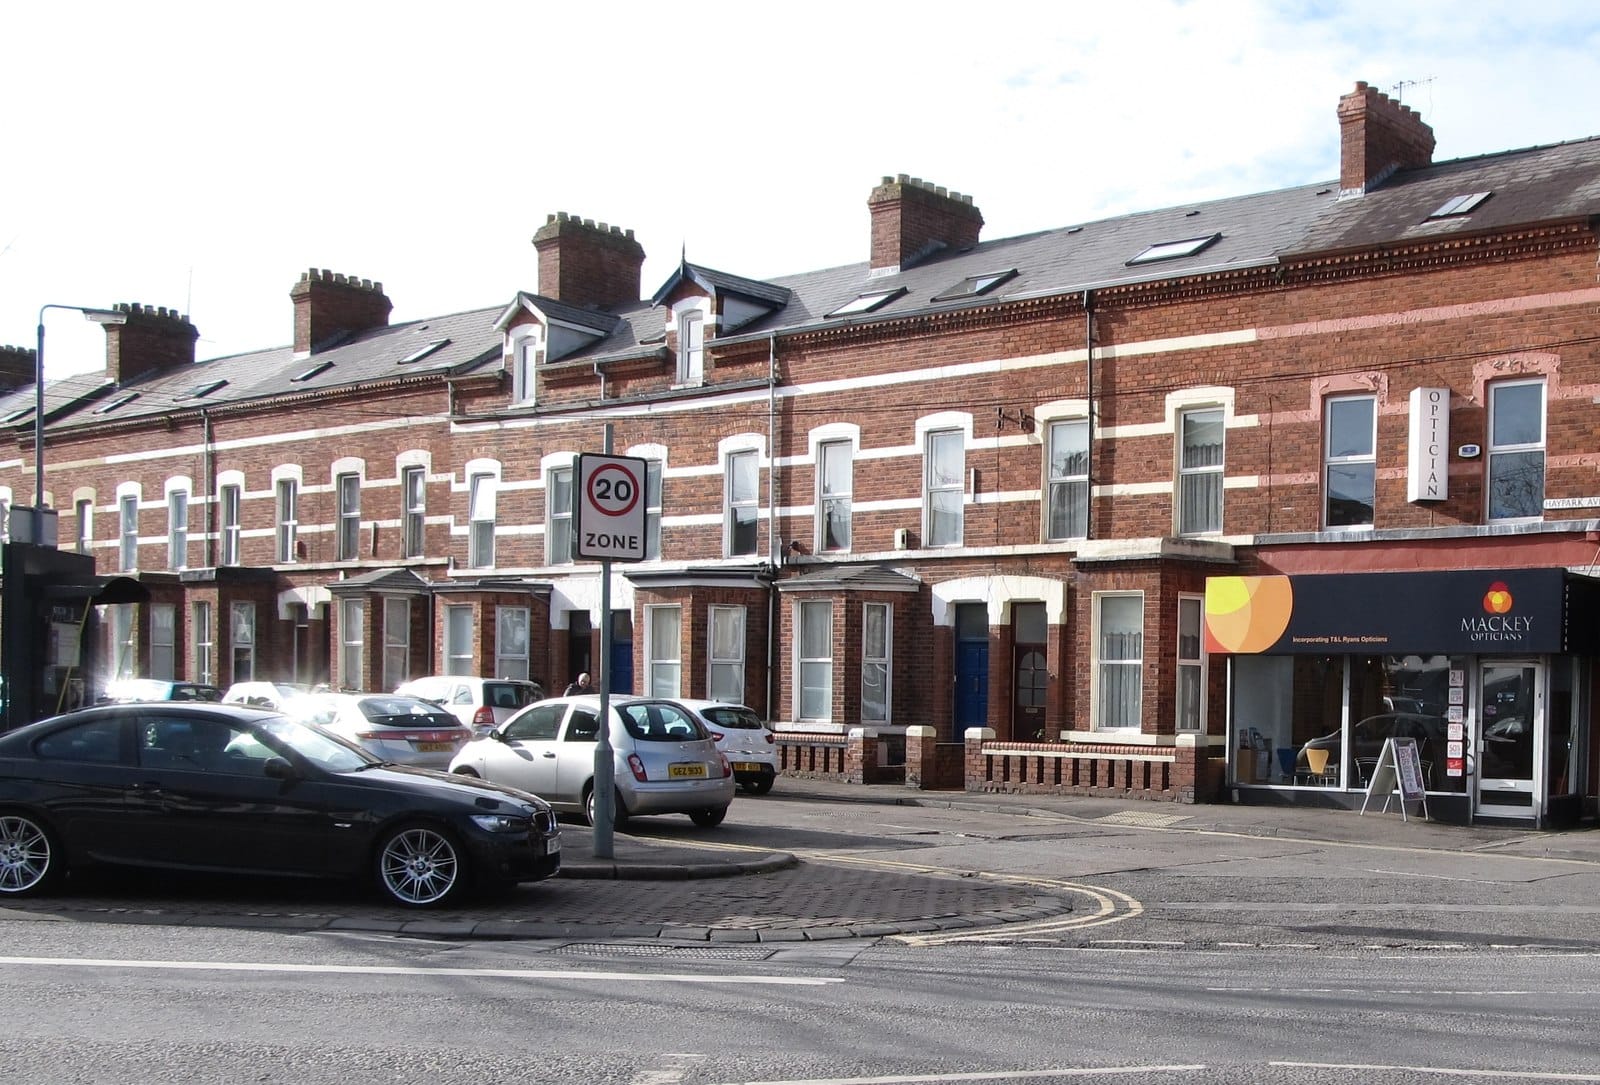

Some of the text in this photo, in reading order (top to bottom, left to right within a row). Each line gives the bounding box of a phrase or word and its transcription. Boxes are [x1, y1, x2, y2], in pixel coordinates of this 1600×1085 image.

[1427, 391, 1440, 496] OPTICIAN
[596, 478, 631, 501] 20
[1545, 498, 1600, 508] HAYPARK AV
[586, 533, 638, 549] ZONE
[1460, 616, 1534, 632] MACKEY
[1470, 632, 1522, 641] OPTICIANS
